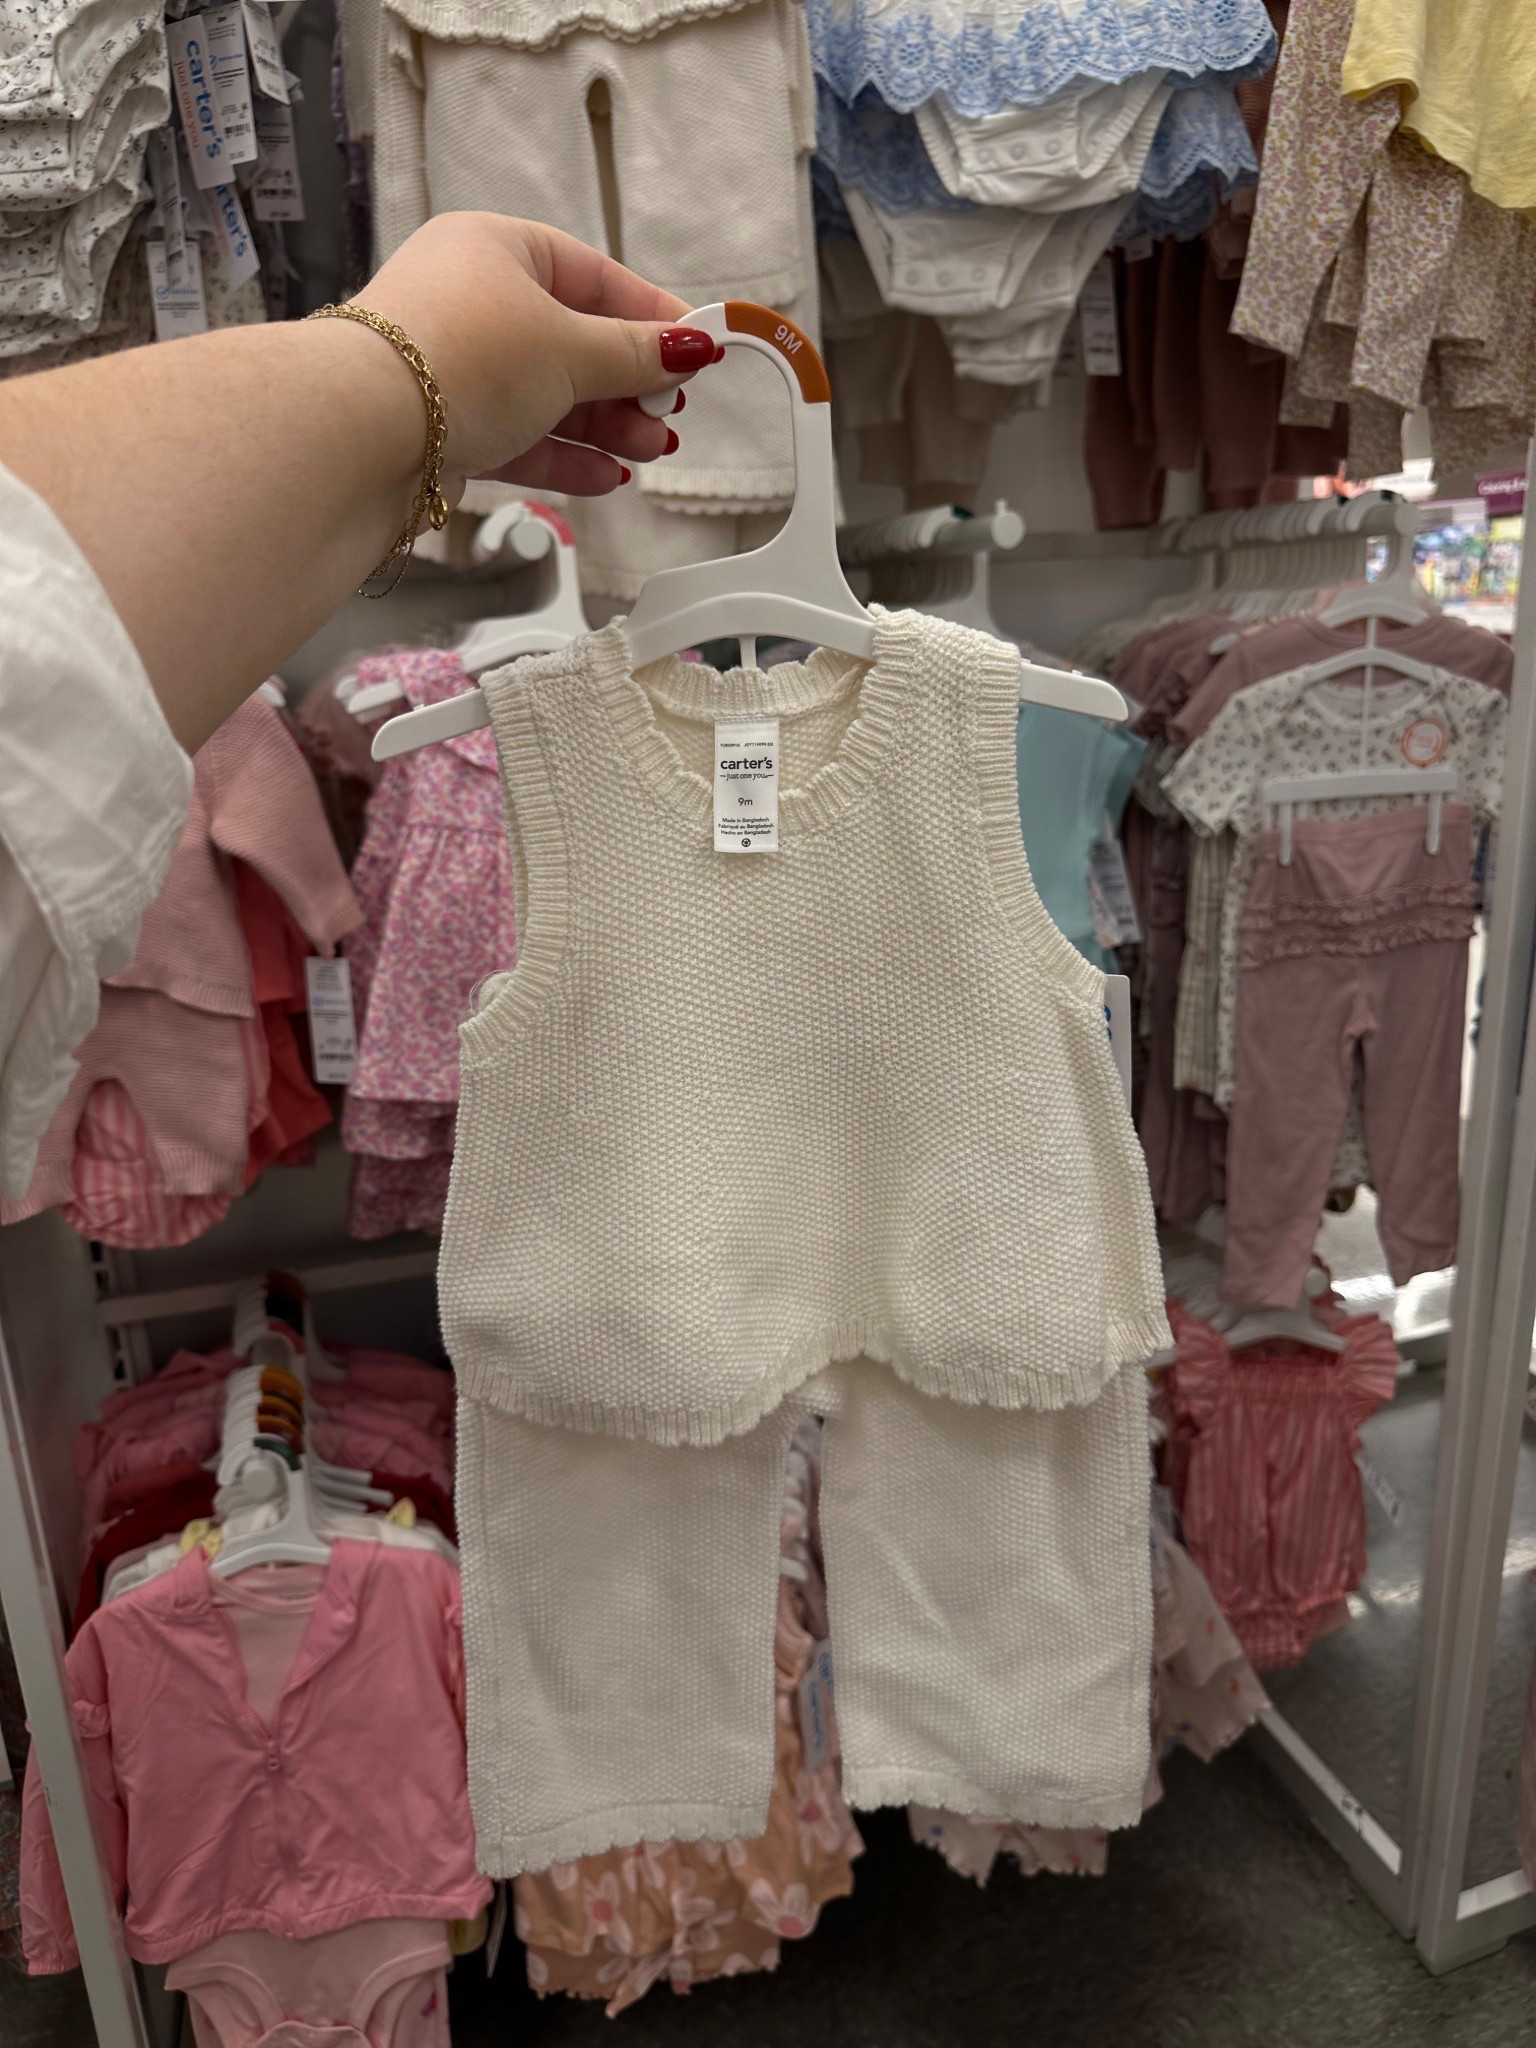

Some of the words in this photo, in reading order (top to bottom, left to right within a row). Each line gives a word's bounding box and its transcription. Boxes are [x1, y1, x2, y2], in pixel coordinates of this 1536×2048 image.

[173, 60, 189, 88] just
[185, 118, 200, 149] you
[187, 40, 223, 158] carter's
[216, 185, 248, 257] rter's
[774, 324, 803, 355] 9M
[720, 756, 773, 770] carter's
[726, 772, 739, 781] just
[738, 797, 753, 806] 9m
